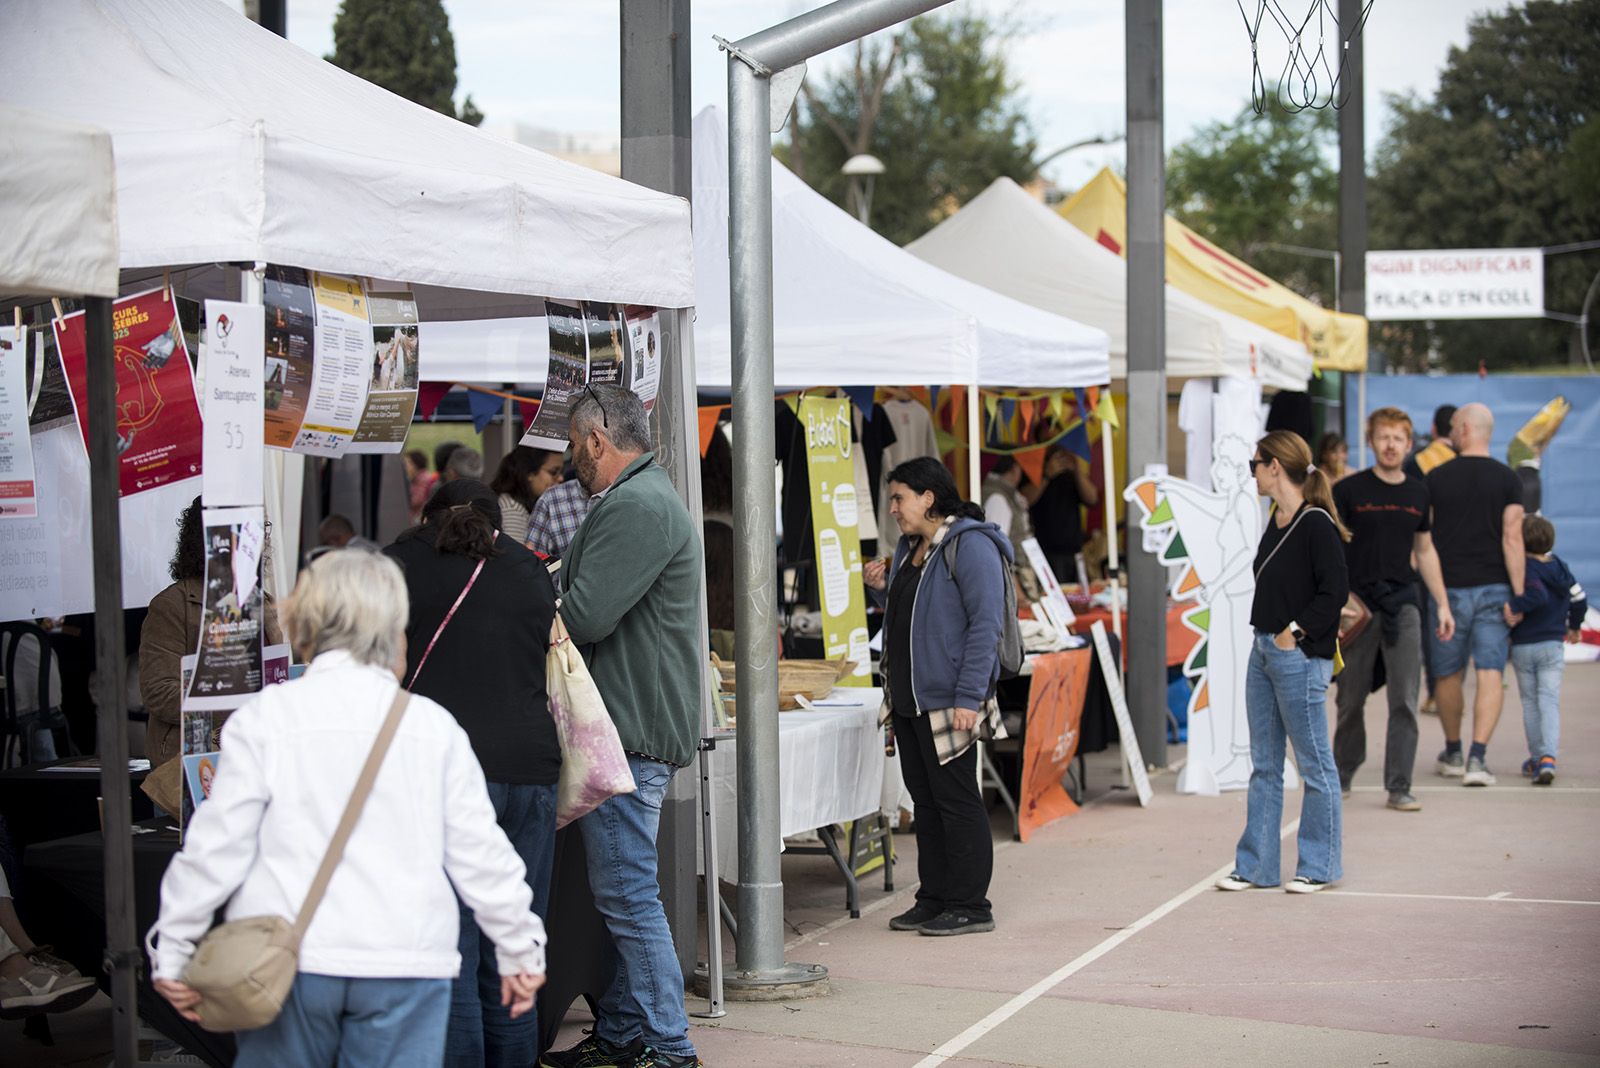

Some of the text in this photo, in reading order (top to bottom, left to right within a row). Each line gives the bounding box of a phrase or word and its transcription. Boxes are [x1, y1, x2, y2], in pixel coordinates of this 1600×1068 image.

[1420, 256, 1532, 273] DIGNIFICAR
[1374, 290, 1432, 308] PLAÇA
[1487, 288, 1533, 305] COLL
[113, 312, 149, 331] SEBRES
[224, 421, 244, 450] 33
